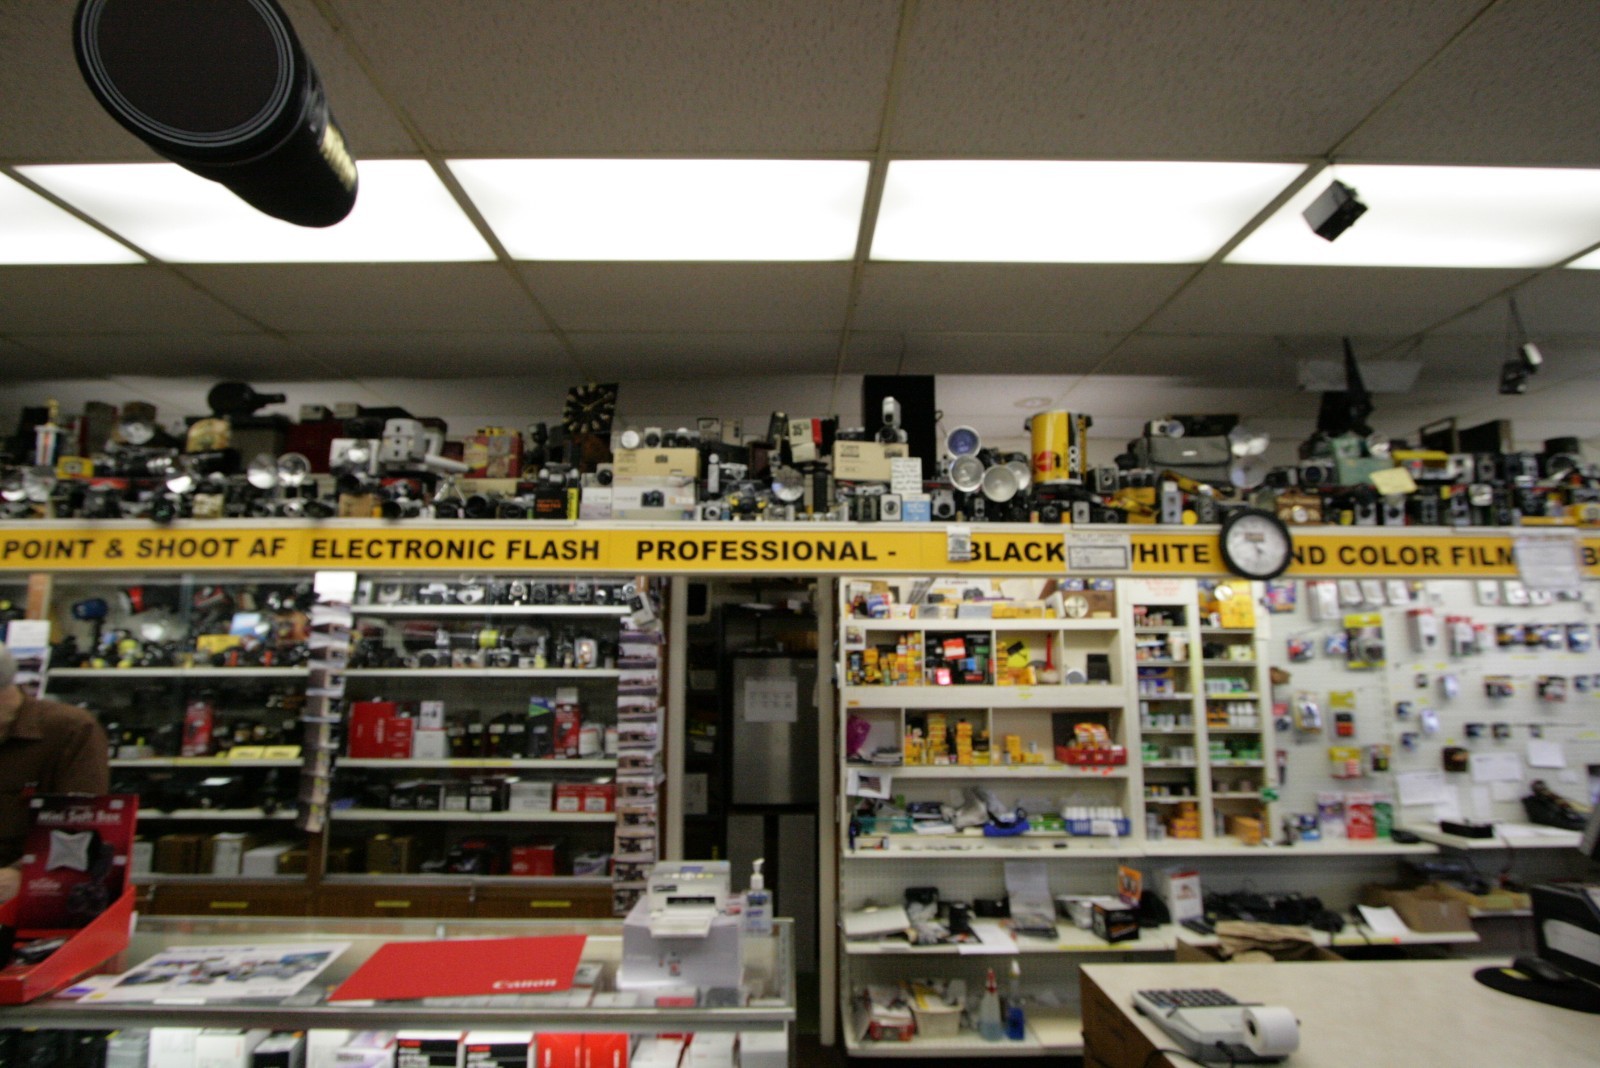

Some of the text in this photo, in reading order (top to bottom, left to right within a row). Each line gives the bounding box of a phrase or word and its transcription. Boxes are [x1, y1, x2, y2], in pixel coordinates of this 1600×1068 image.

[2, 538, 286, 559] POINT & SHOOT AF
[311, 539, 599, 560] ELECTRONIC FLASH
[637, 541, 877, 561] PROFESSIONAL
[1339, 546, 1440, 566] COLOR
[491, 978, 558, 989] Canon
